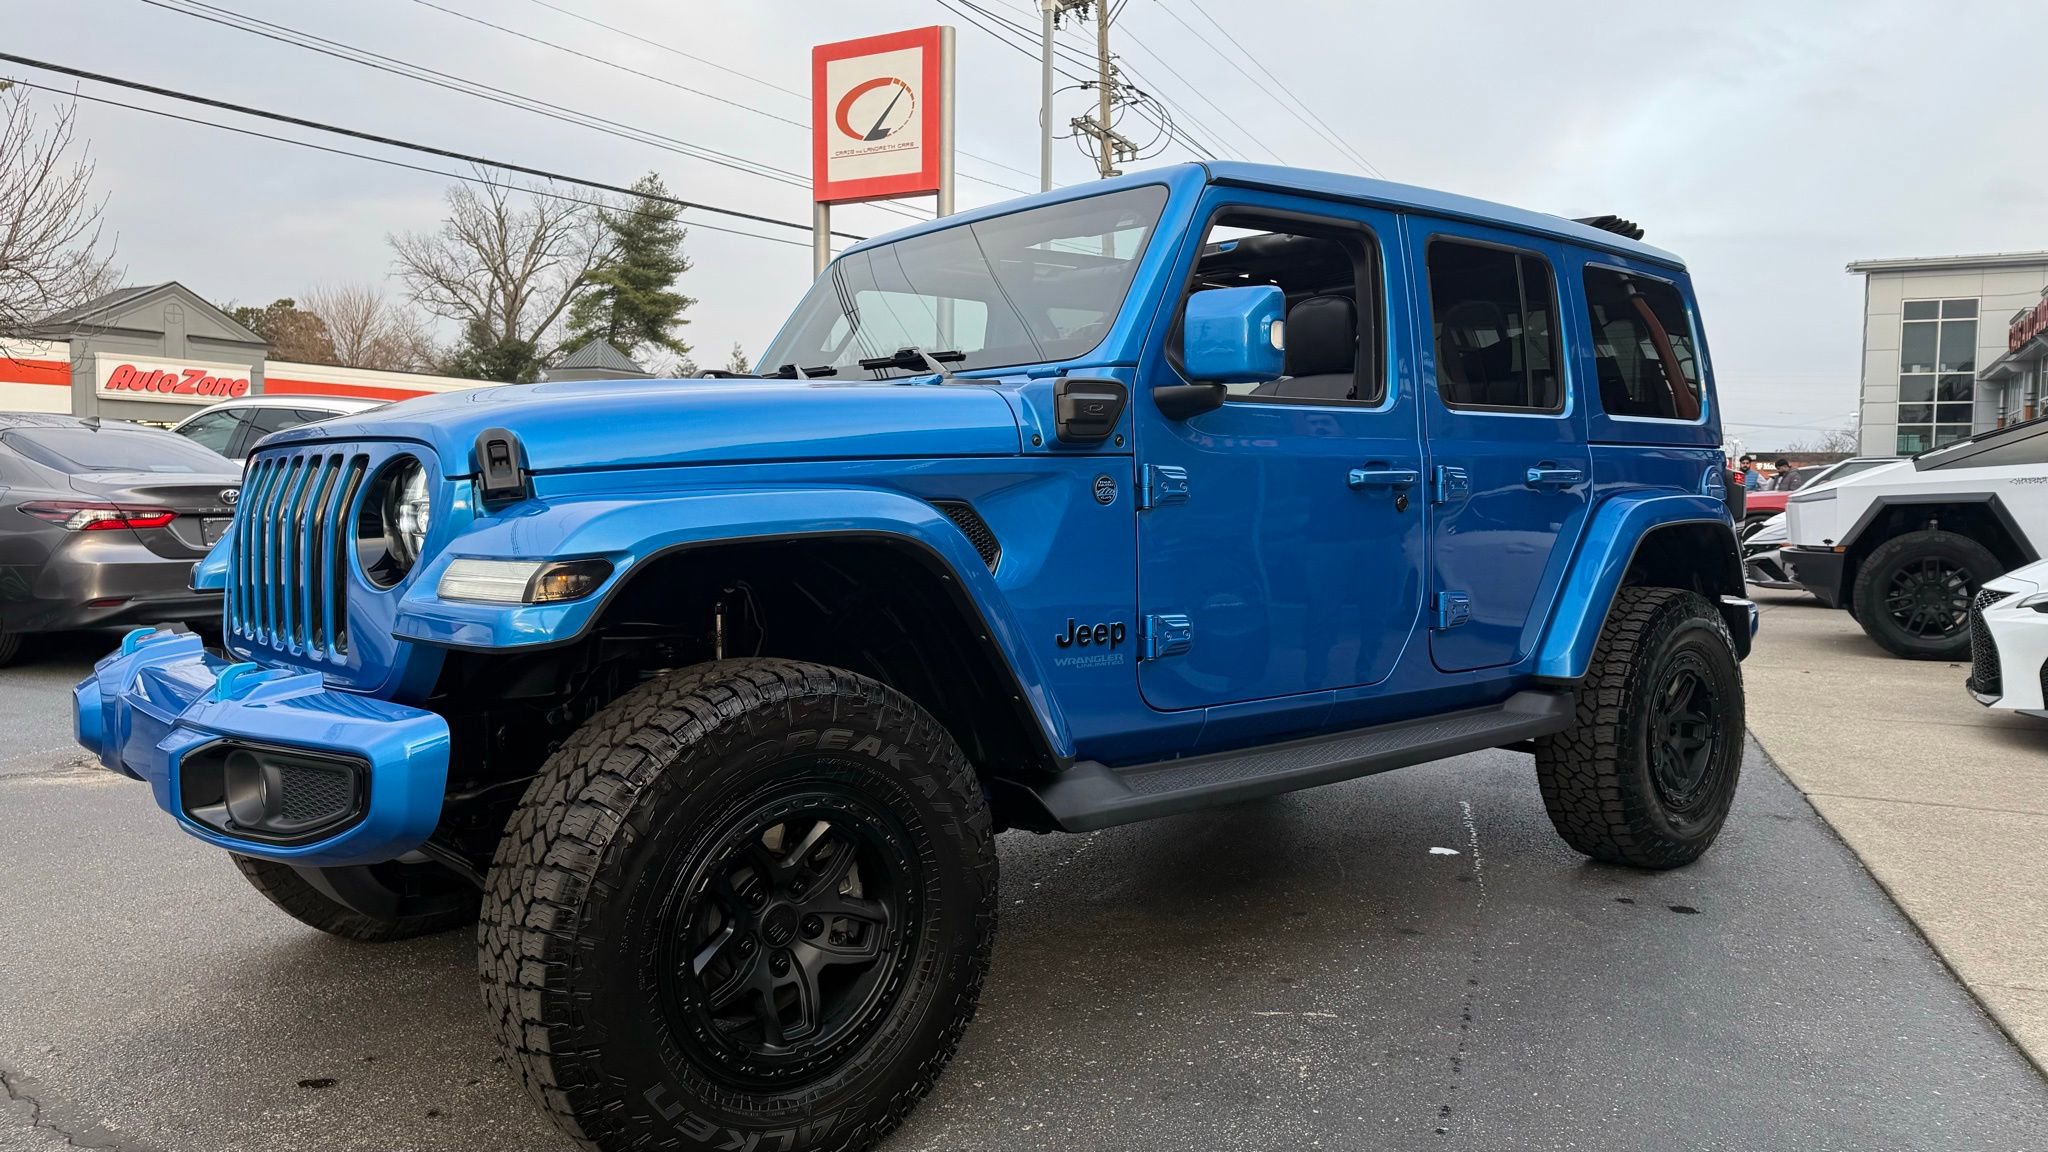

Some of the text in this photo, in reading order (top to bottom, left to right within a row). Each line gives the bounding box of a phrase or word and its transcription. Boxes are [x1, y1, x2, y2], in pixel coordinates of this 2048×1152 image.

[105, 364, 249, 398] AutoZone
[1055, 617, 1126, 651] Jeep
[1055, 653, 1125, 667] WRANGLER
[1076, 660, 1125, 669] UNLIMITED
